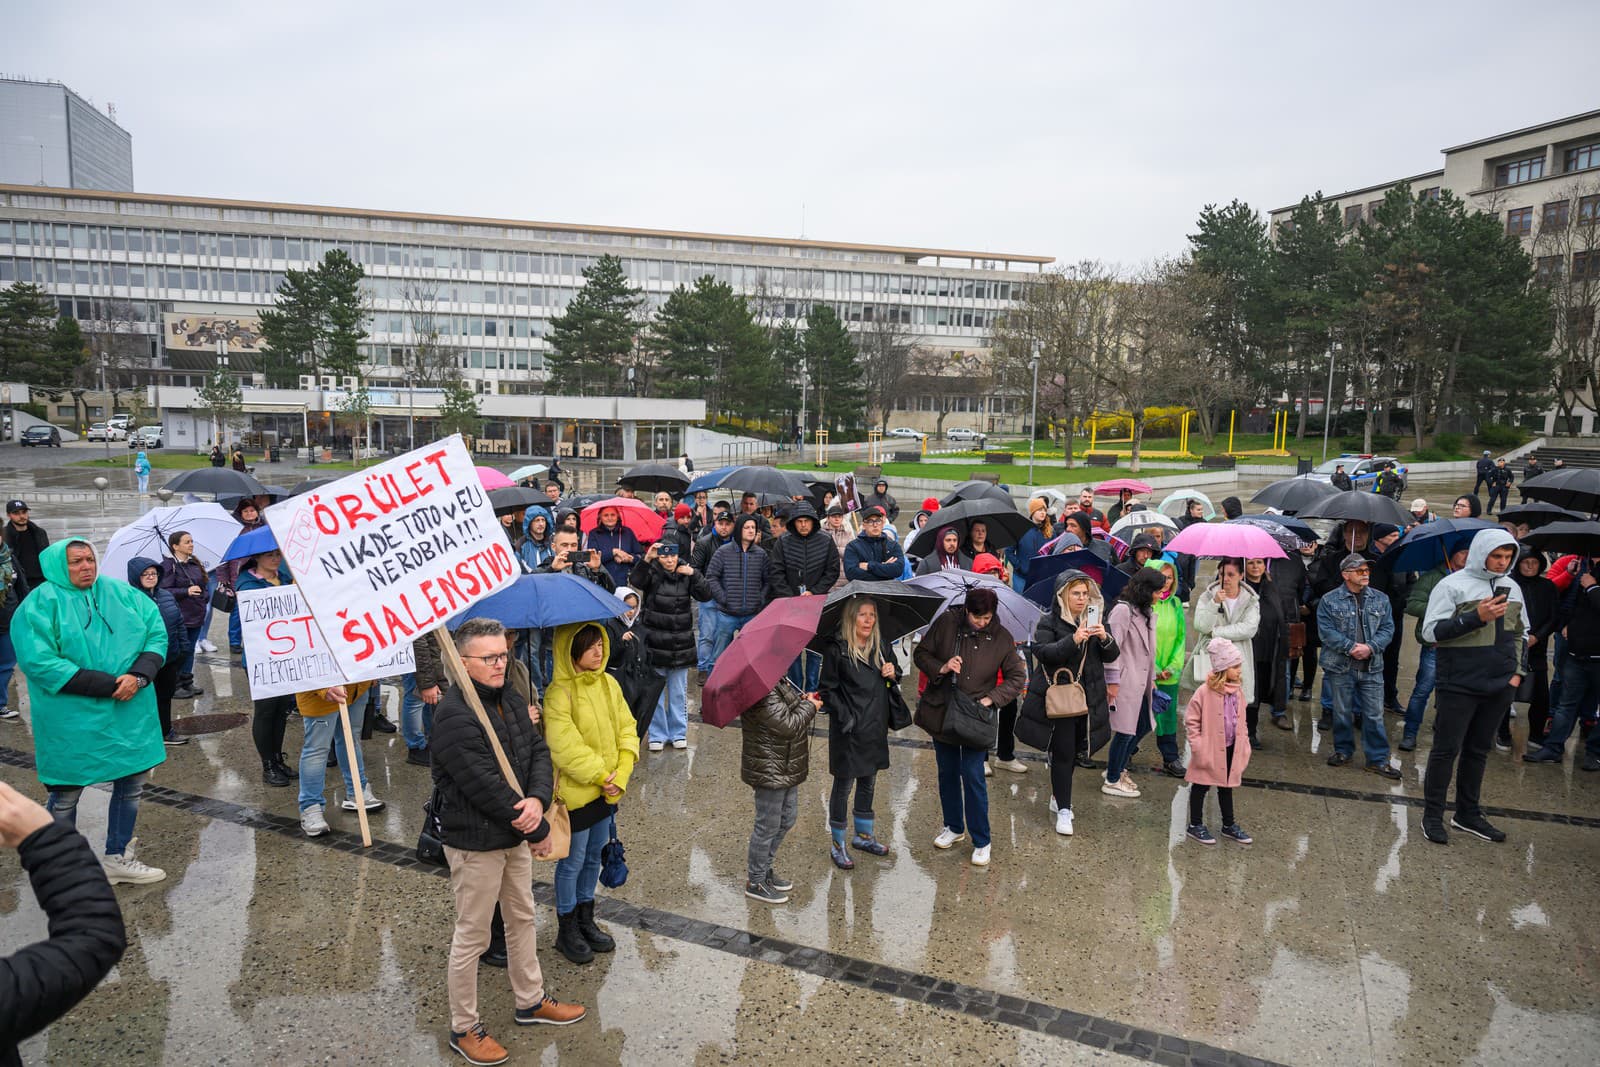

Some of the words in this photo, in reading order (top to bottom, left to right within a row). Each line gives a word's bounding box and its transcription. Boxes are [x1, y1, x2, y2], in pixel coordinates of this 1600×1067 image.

[287, 513, 317, 567] STOP
[319, 523, 403, 579] NIKDE
[395, 504, 442, 540] TOTO
[455, 485, 483, 514] EU
[265, 616, 315, 656] ST
[335, 543, 513, 662] ŠIALENSTVO
